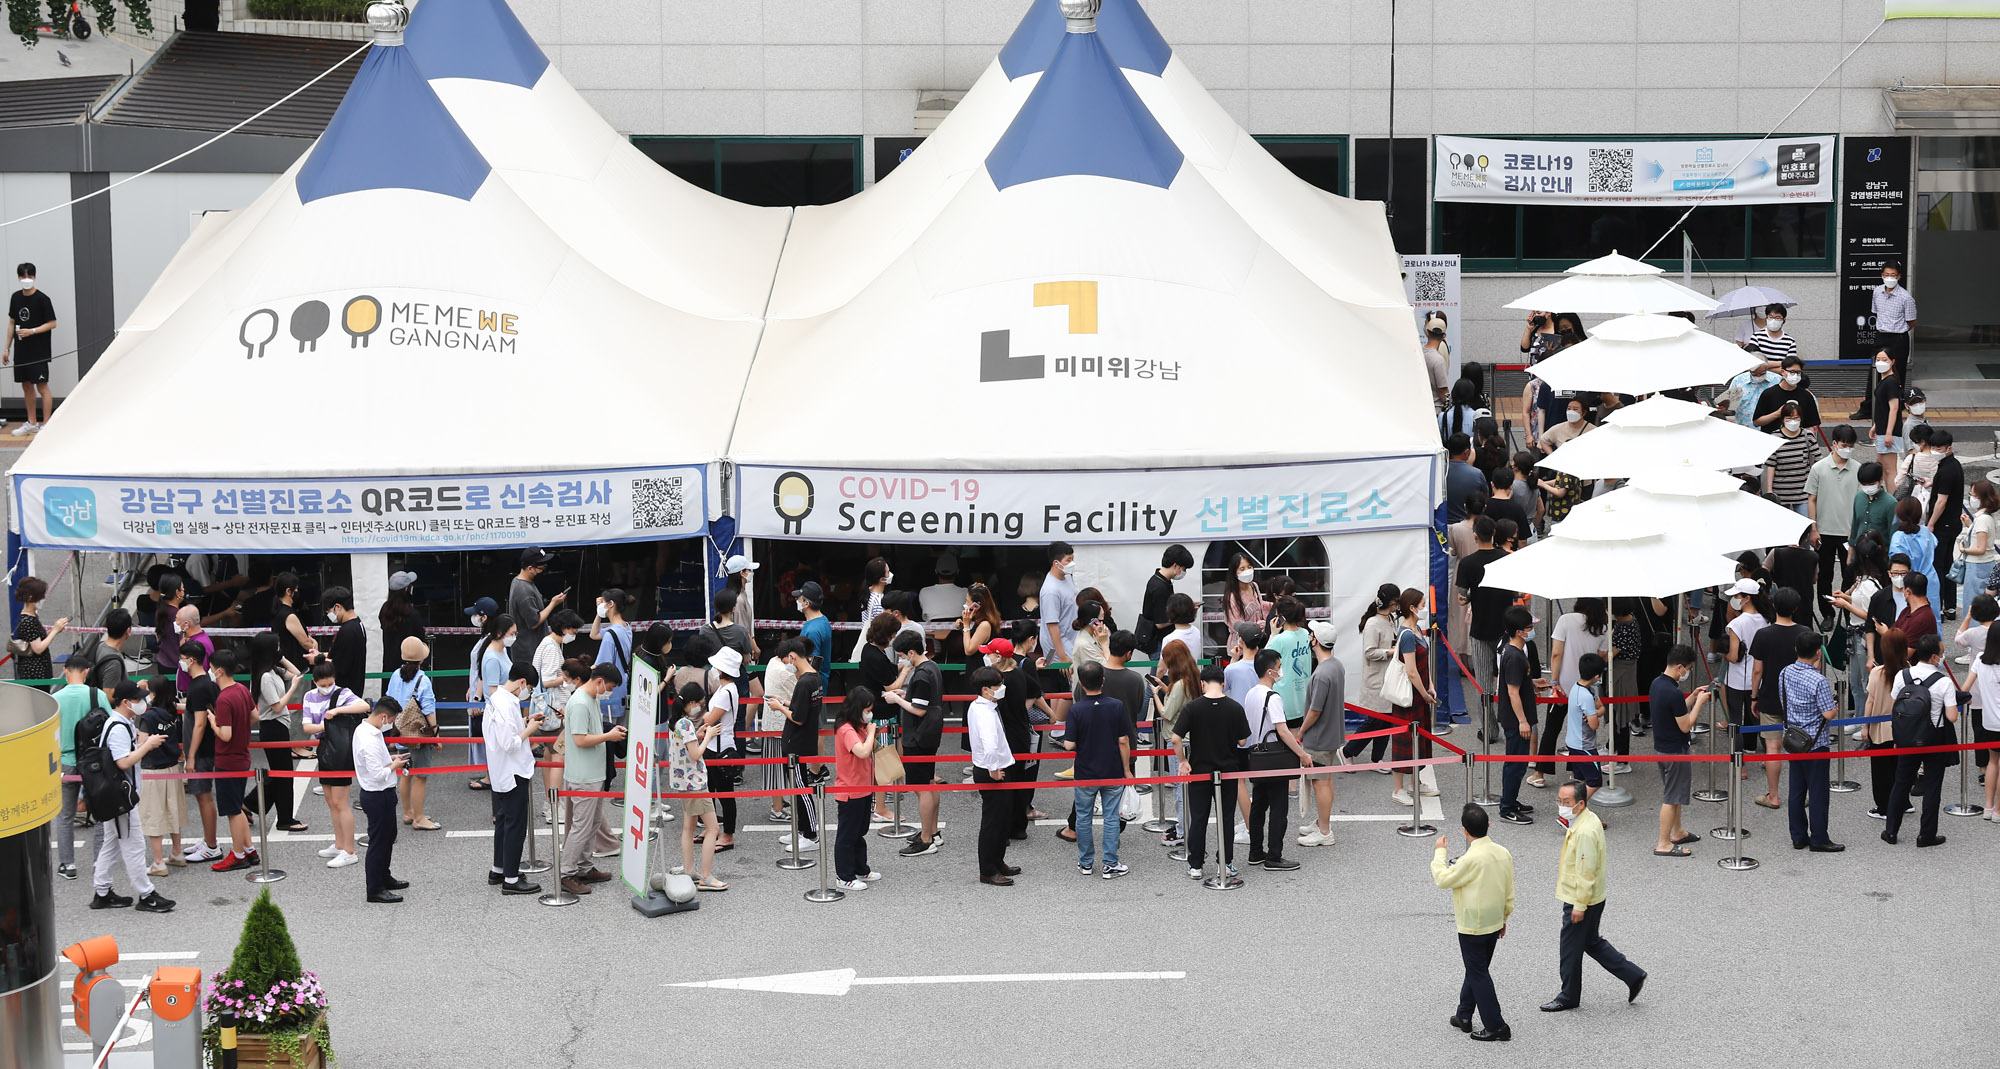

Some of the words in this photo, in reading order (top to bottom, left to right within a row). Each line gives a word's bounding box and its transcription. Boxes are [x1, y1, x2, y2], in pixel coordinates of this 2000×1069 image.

[1503, 153, 1573, 171] 코로나19
[1451, 179, 1487, 189] GANGNAM
[1452, 172, 1474, 181] MEME
[1504, 175, 1536, 193] 검사
[1541, 175, 1573, 194] 안내
[1865, 181, 1889, 190] 강남구
[1850, 191, 1903, 200] 감염병관리센터
[1404, 260, 1430, 268] 코로나19
[1445, 259, 1457, 267] 안내
[391, 302, 472, 329] MEME
[390, 328, 516, 354] GANGNAM
[1055, 355, 1181, 381] 미미위강남
[120, 487, 203, 514] 강남구
[211, 487, 353, 515] 선별진료소
[361, 485, 491, 514] QR코드로
[499, 478, 613, 509] 신속검사
[838, 476, 980, 501] COVID-19
[837, 502, 1024, 539] Screening
[1043, 501, 1178, 537] Facility
[1194, 488, 1393, 534] 선별진료소
[123, 520, 156, 535] 더강남
[173, 521, 184, 535] 앱
[187, 521, 209, 535] 실행
[223, 521, 245, 535] 상단
[248, 521, 301, 535] 전자문진표
[304, 521, 326, 535] 클릭
[341, 519, 427, 535] 인터넷주소(URL)
[429, 518, 451, 532] 클릭
[453, 518, 475, 531] 또는
[477, 516, 516, 530] QR코드
[518, 515, 540, 529] 촬영
[554, 513, 587, 527] 문진표
[590, 512, 612, 526] 작성
[341, 530, 526, 544] https://covid19m.kdca.go.kr/phc/11700190
